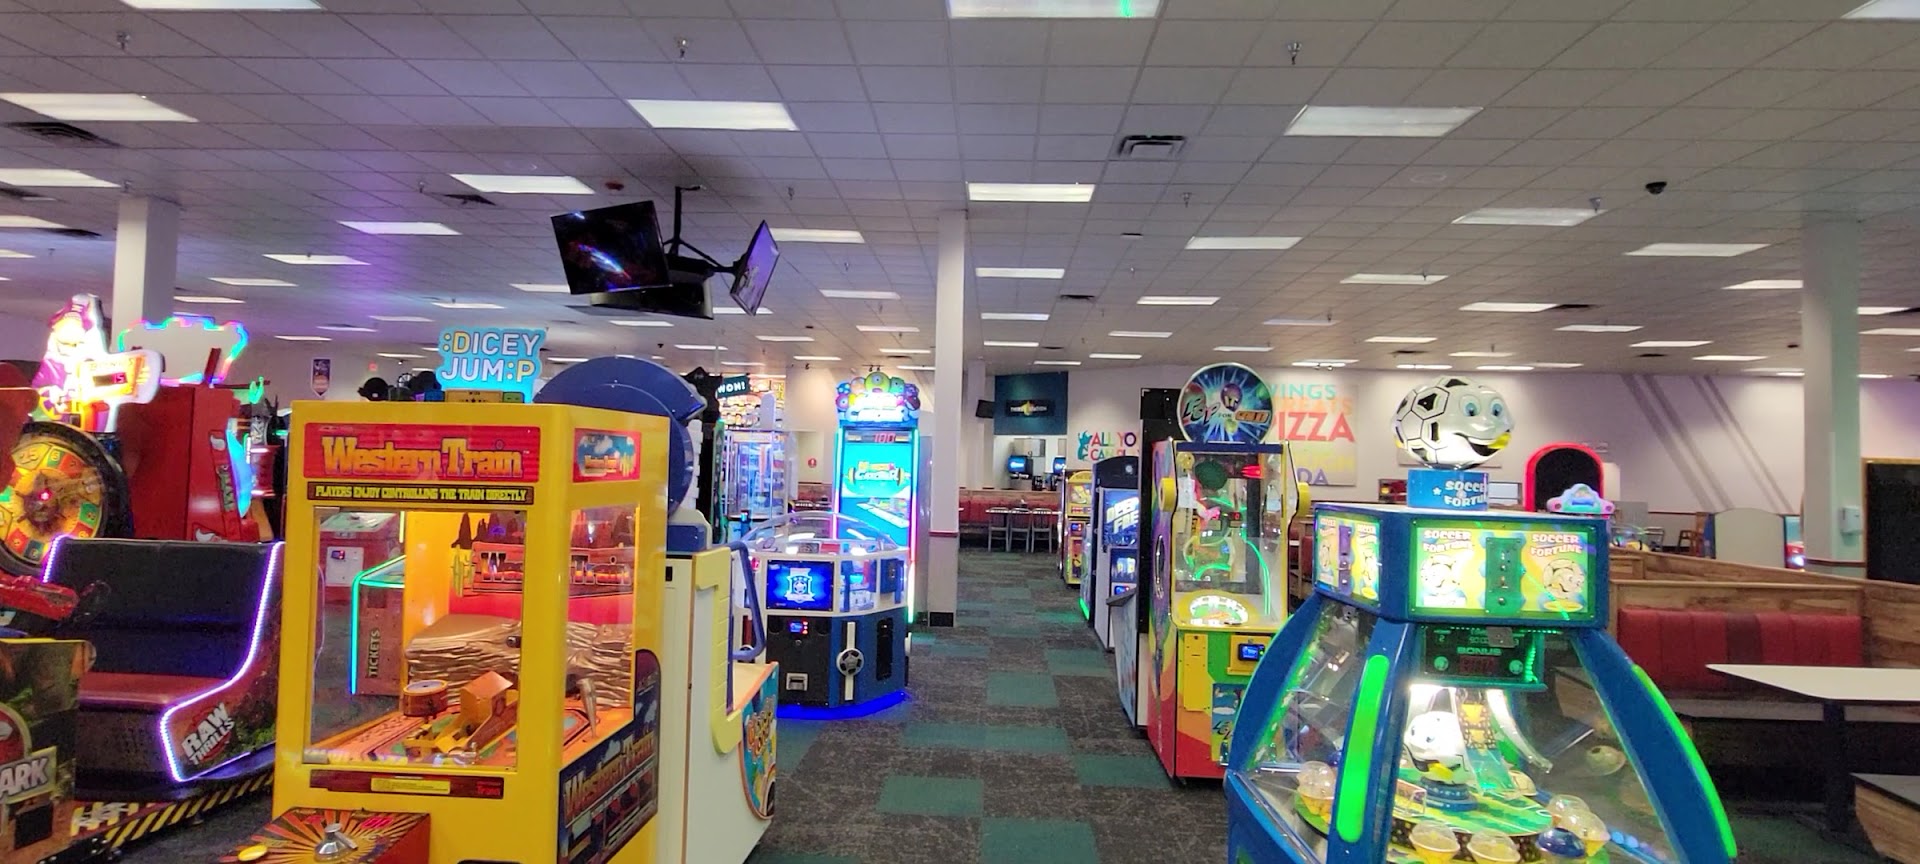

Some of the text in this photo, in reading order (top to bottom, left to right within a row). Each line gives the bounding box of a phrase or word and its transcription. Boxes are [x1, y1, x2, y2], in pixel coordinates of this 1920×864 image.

[1271, 411, 1356, 443] IZZA
[1091, 432, 1114, 447] ALL
[321, 436, 524, 478] Western Train
[315, 485, 352, 498] PLAYERS
[353, 486, 380, 499] ENJOY
[440, 488, 457, 500] THE
[458, 488, 484, 500] TRAIN
[1445, 481, 1485, 493] SOCCE
[1444, 495, 1485, 507] FORTU
[1423, 529, 1472, 540] SOCCER
[1532, 533, 1580, 544] SOCCER
[1531, 544, 1583, 558] FORTUNE
[368, 629, 381, 678] TICKETS
[1456, 646, 1502, 656] BONUS
[181, 702, 229, 759] RAW
[190, 717, 235, 765] THRILLS
[0, 757, 49, 798] ARK
